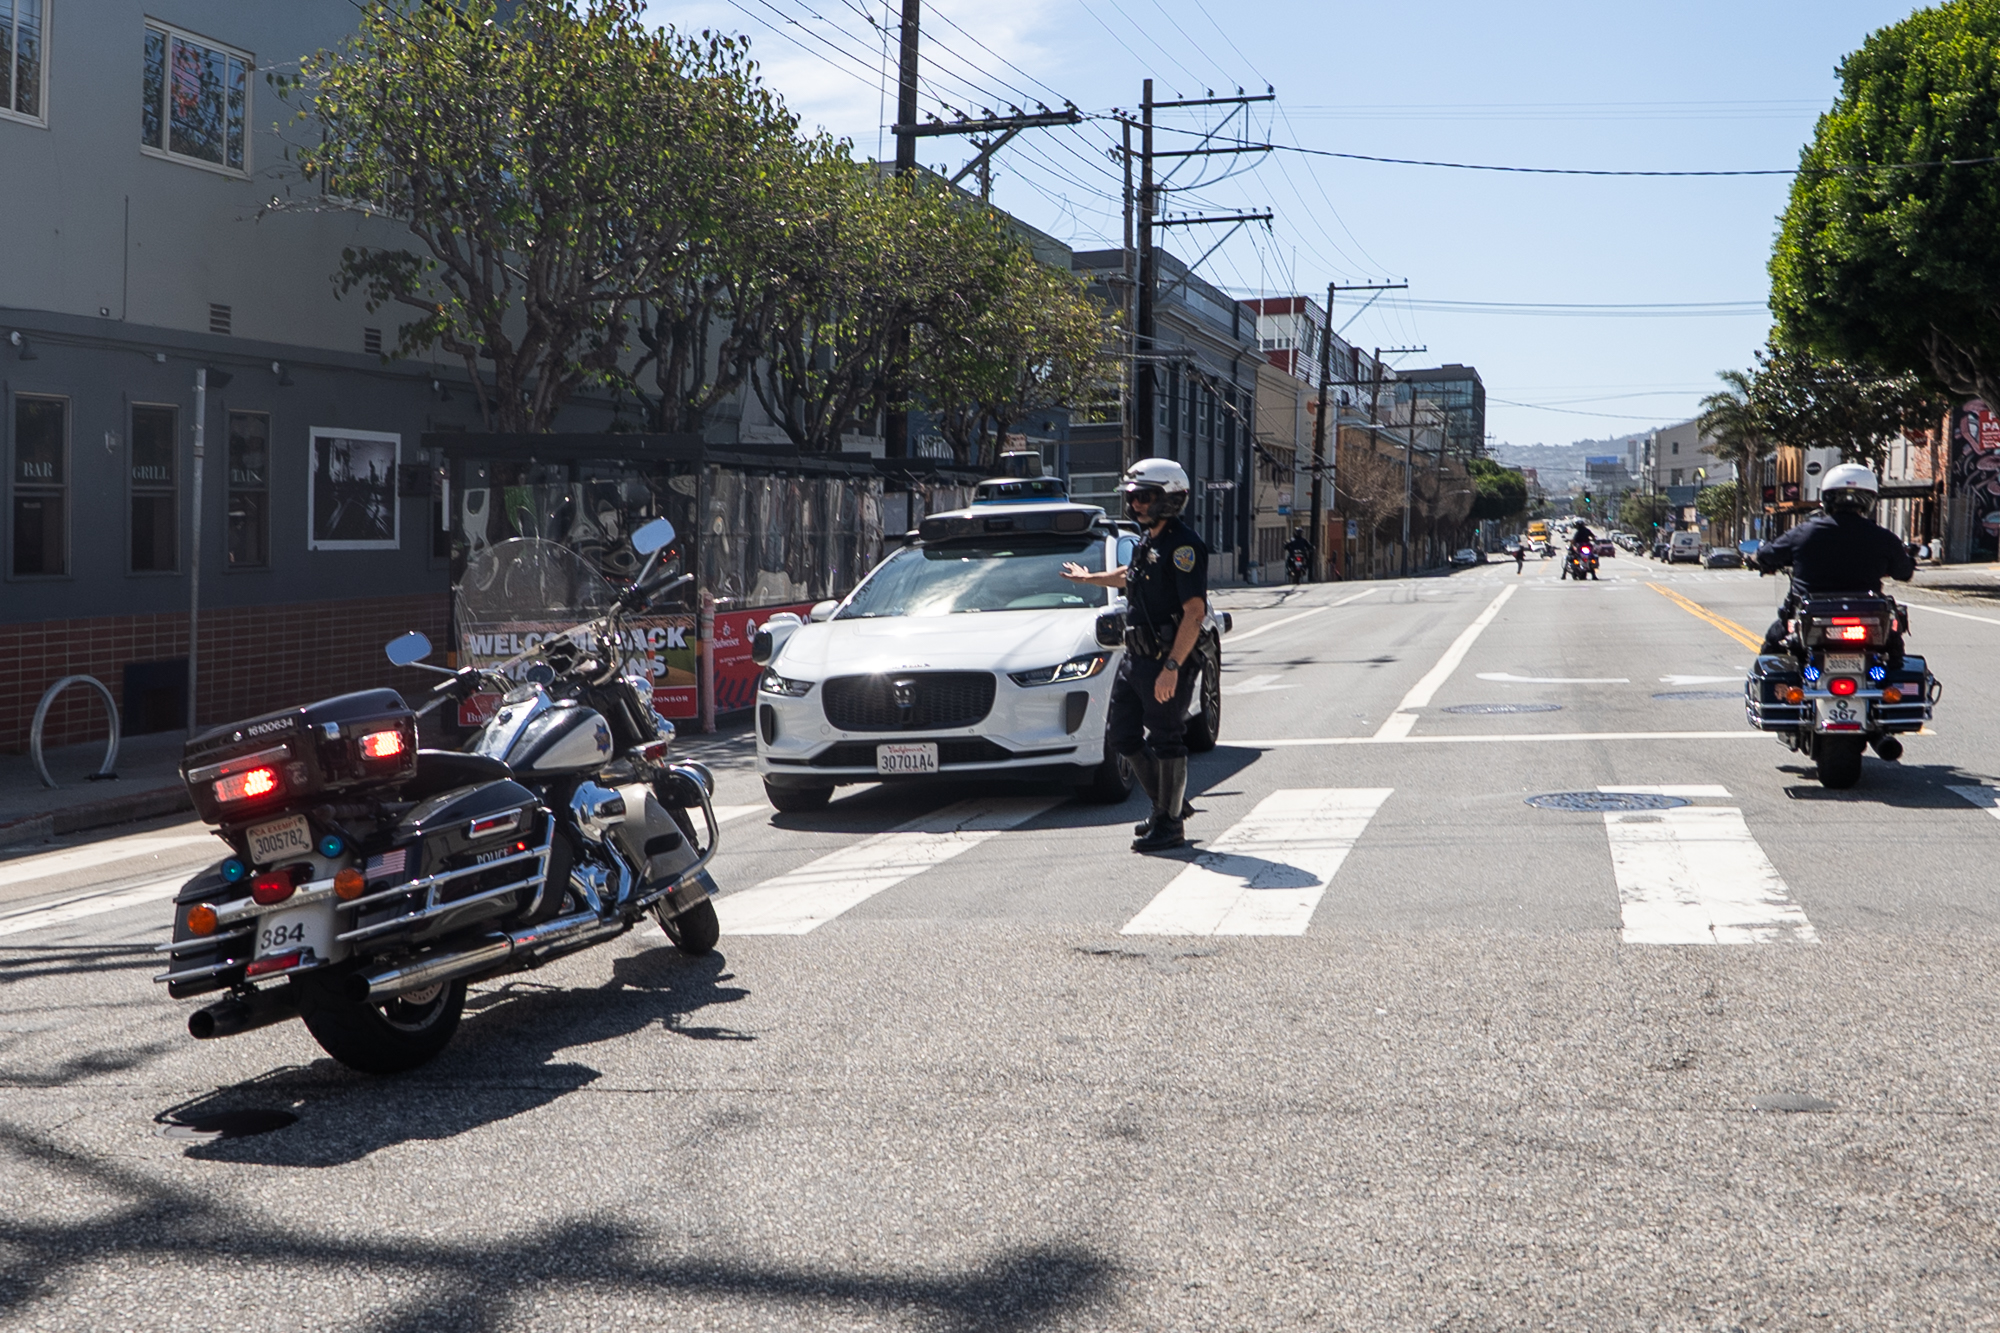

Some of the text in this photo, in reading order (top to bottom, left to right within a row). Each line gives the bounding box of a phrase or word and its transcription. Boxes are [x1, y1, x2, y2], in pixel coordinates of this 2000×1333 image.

[23, 461, 53, 477] BAR
[132, 465, 171, 480] GRILL
[652, 695, 689, 703] PONSOR
[1828, 709, 1857, 721] 367
[881, 754, 935, 771] 30701A4
[255, 828, 304, 855] 3005782
[260, 922, 305, 950] 384
